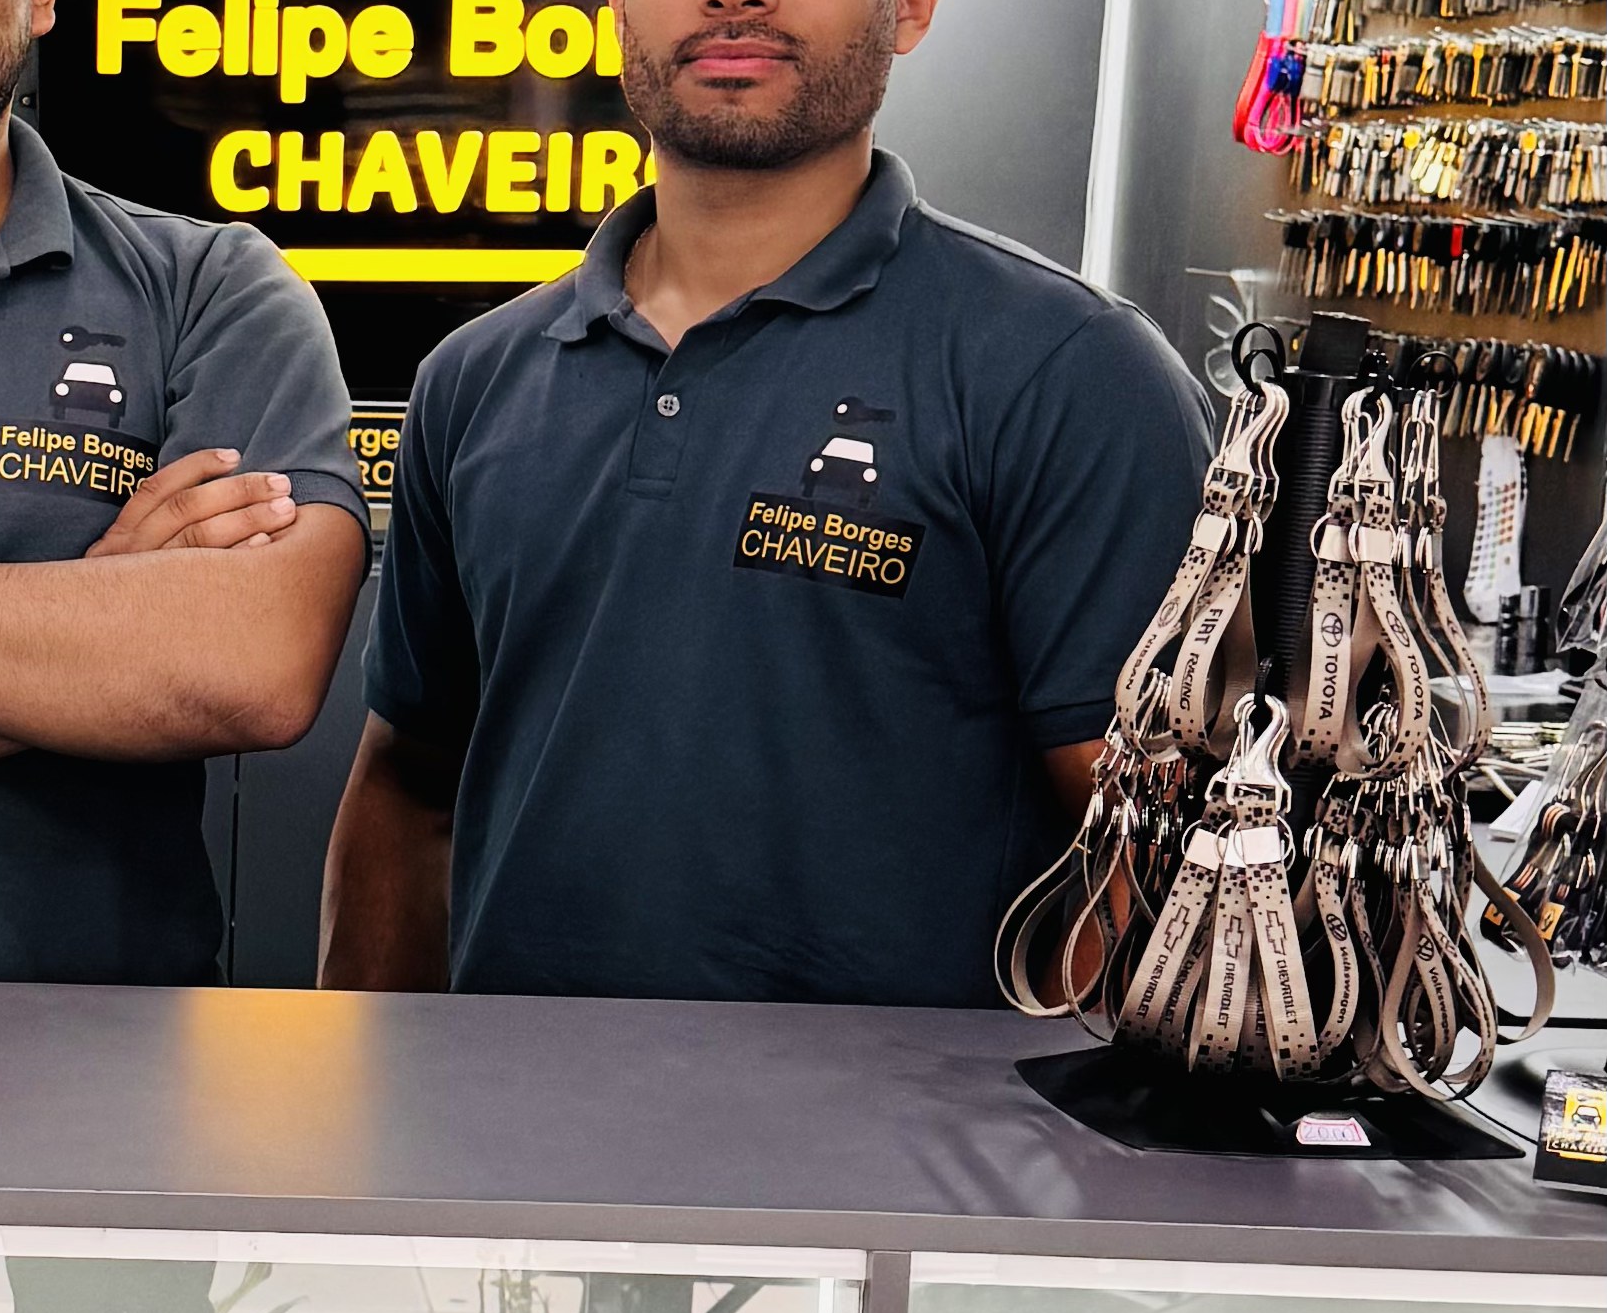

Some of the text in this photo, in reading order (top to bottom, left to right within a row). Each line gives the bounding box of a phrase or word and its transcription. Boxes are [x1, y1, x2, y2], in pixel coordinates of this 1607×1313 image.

[209, 130, 657, 213] CHAVEIR
[0, 425, 154, 473] Felipe Borges
[741, 529, 906, 585] CHAVEIRO
[748, 501, 913, 553] Felipe Borges
[1125, 633, 1158, 690] NISSAN
[1179, 607, 1223, 712] FIAT RACING
[1318, 653, 1339, 721] TOYOTA
[1407, 653, 1425, 721] TOYOTA
